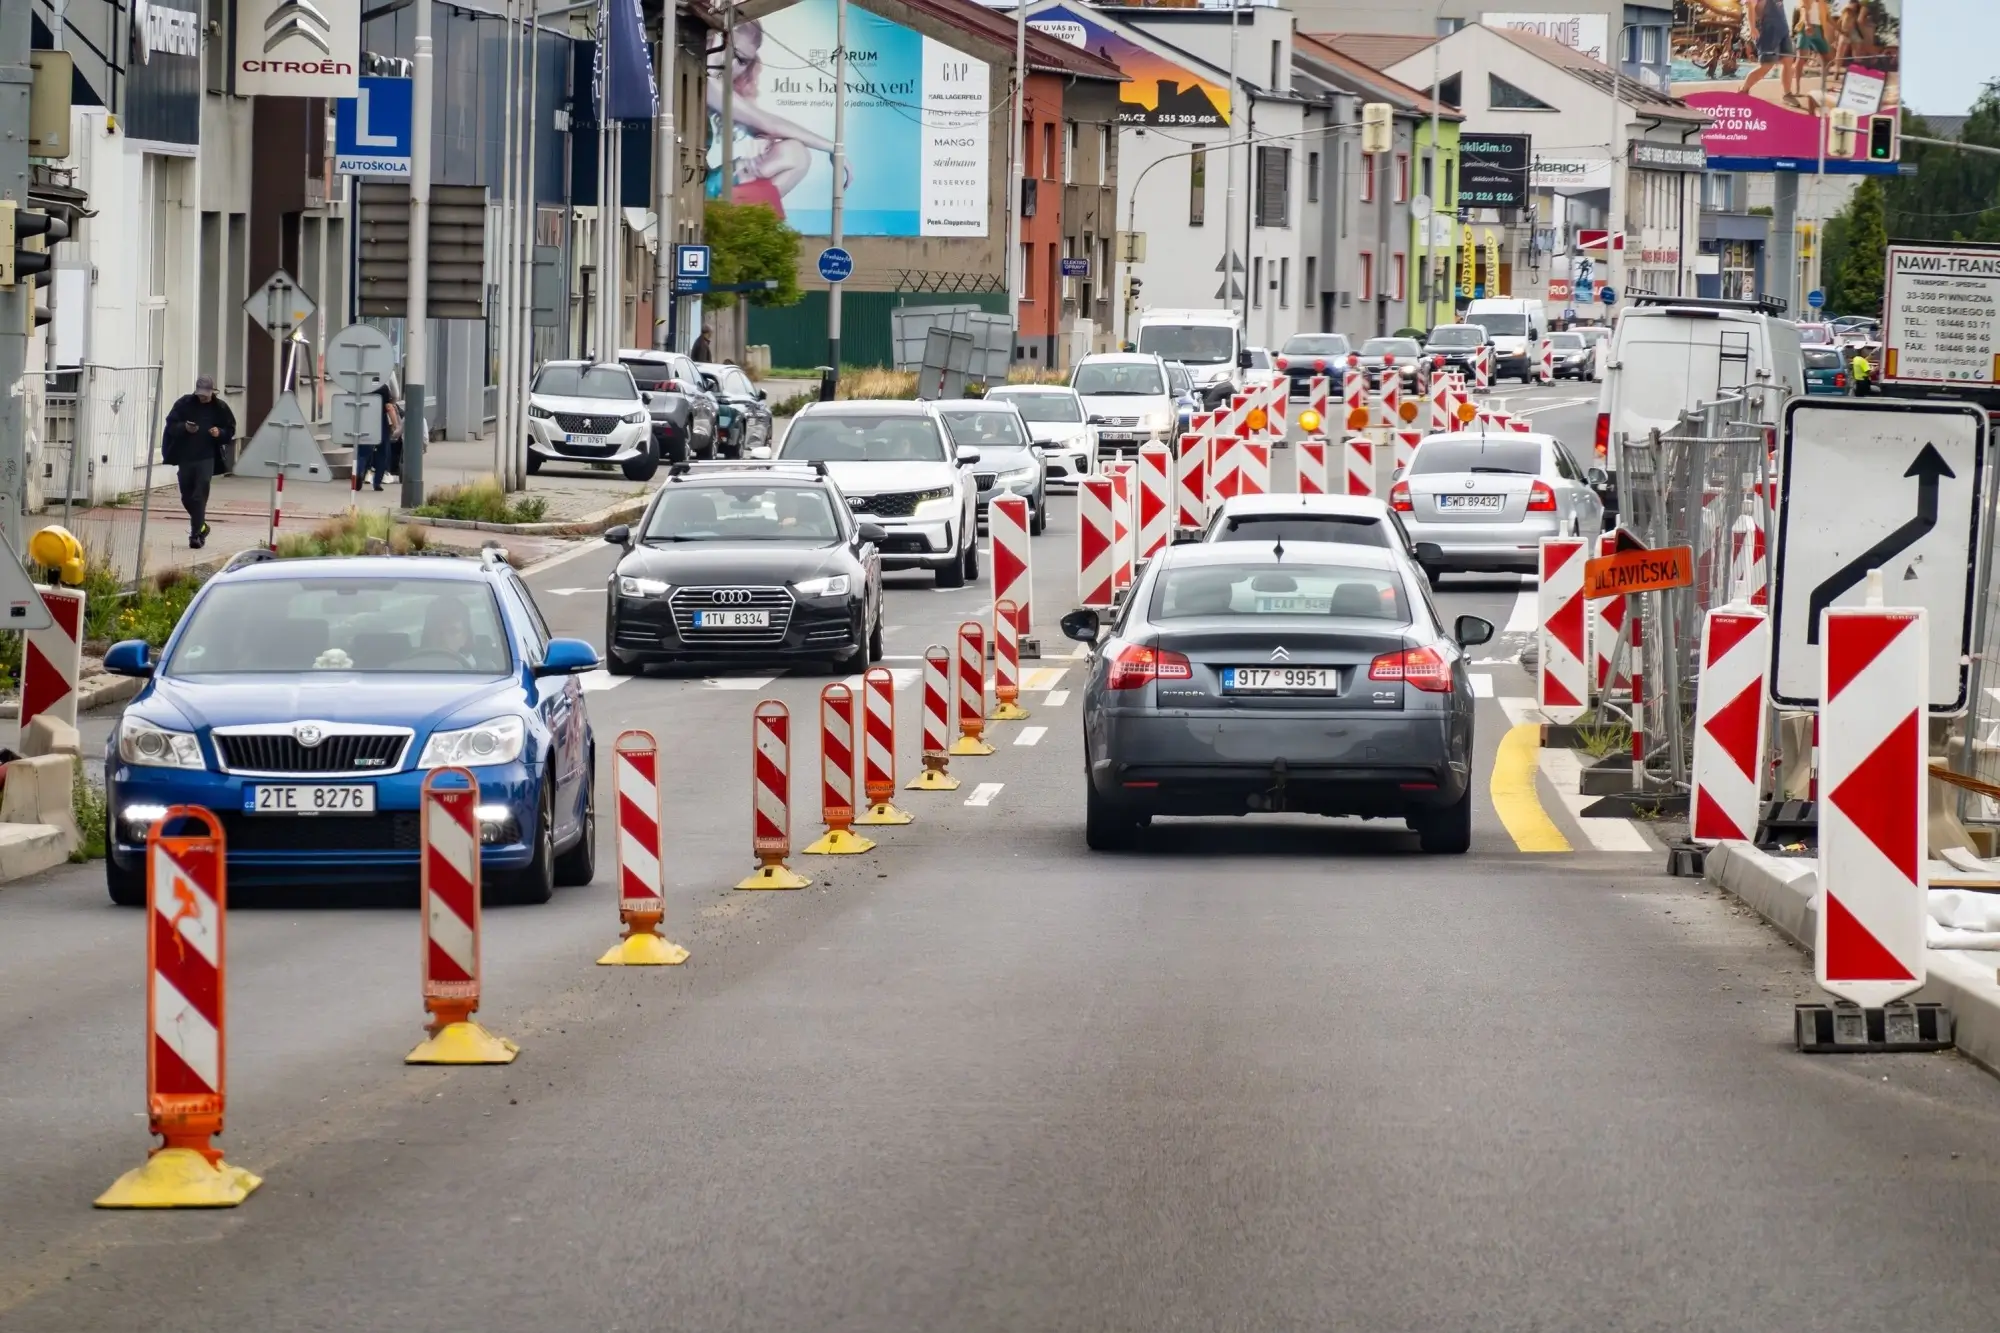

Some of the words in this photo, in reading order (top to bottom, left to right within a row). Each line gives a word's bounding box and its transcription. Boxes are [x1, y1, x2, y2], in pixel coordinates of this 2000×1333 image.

[830, 50, 878, 61] FRUM
[243, 59, 352, 75] CITROËN
[943, 62, 968, 81] GAP
[771, 77, 800, 94] Jdu
[805, 84, 813, 94] s
[818, 77, 875, 94] bavou
[877, 79, 915, 94] ven!
[850, 100, 873, 108] jednou
[1738, 107, 1751, 118] TO
[1158, 114, 1176, 122] 555
[1178, 115, 1196, 123] 303
[1727, 119, 1742, 130] OD
[1744, 119, 1767, 131] NÁS
[340, 160, 407, 172] AUTOŠKOLA
[1476, 192, 1494, 201] 226
[1496, 192, 1514, 201] 226
[1906, 292, 1936, 300] 33-350
[1939, 293, 1993, 303] PIWNICZNA
[1981, 321, 1991, 329] 71
[1446, 496, 1466, 507] SWD
[1468, 496, 1498, 507] 89432
[704, 613, 726, 625] 1TV
[734, 613, 763, 625] 8334
[1238, 669, 1270, 687] 9T7
[1285, 670, 1328, 687] 9951
[260, 787, 297, 808] 2TE
[313, 787, 364, 808] 8276
